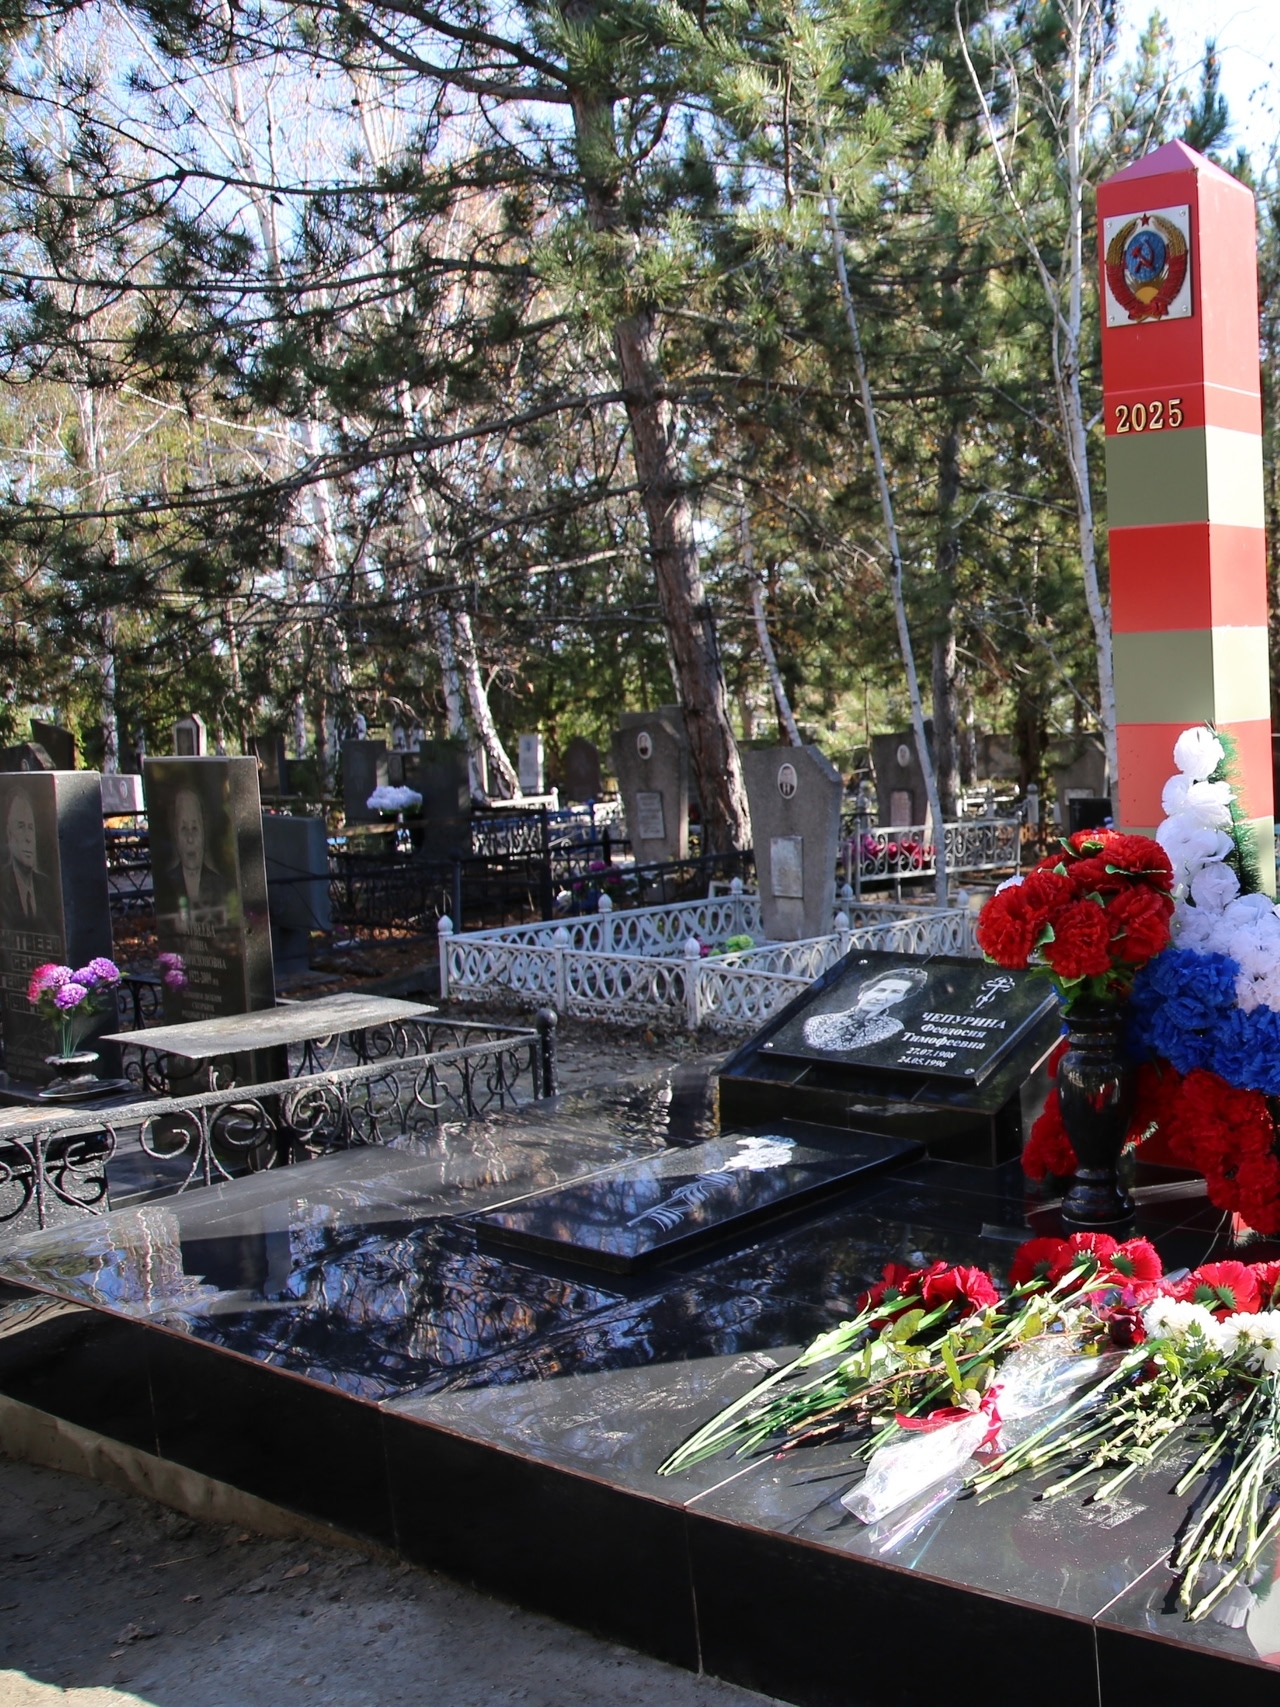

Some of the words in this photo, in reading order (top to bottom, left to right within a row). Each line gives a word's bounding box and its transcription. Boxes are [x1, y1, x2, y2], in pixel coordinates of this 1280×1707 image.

[1115, 398, 1183, 433] 2025
[921, 1012, 1007, 1029] ЧЕПУРИНА
[920, 1023, 987, 1038] Феодосия
[901, 1032, 986, 1050] Тимофеевна
[905, 1047, 957, 1059] 27.07.1908
[897, 1056, 948, 1068] 24.05.1996
